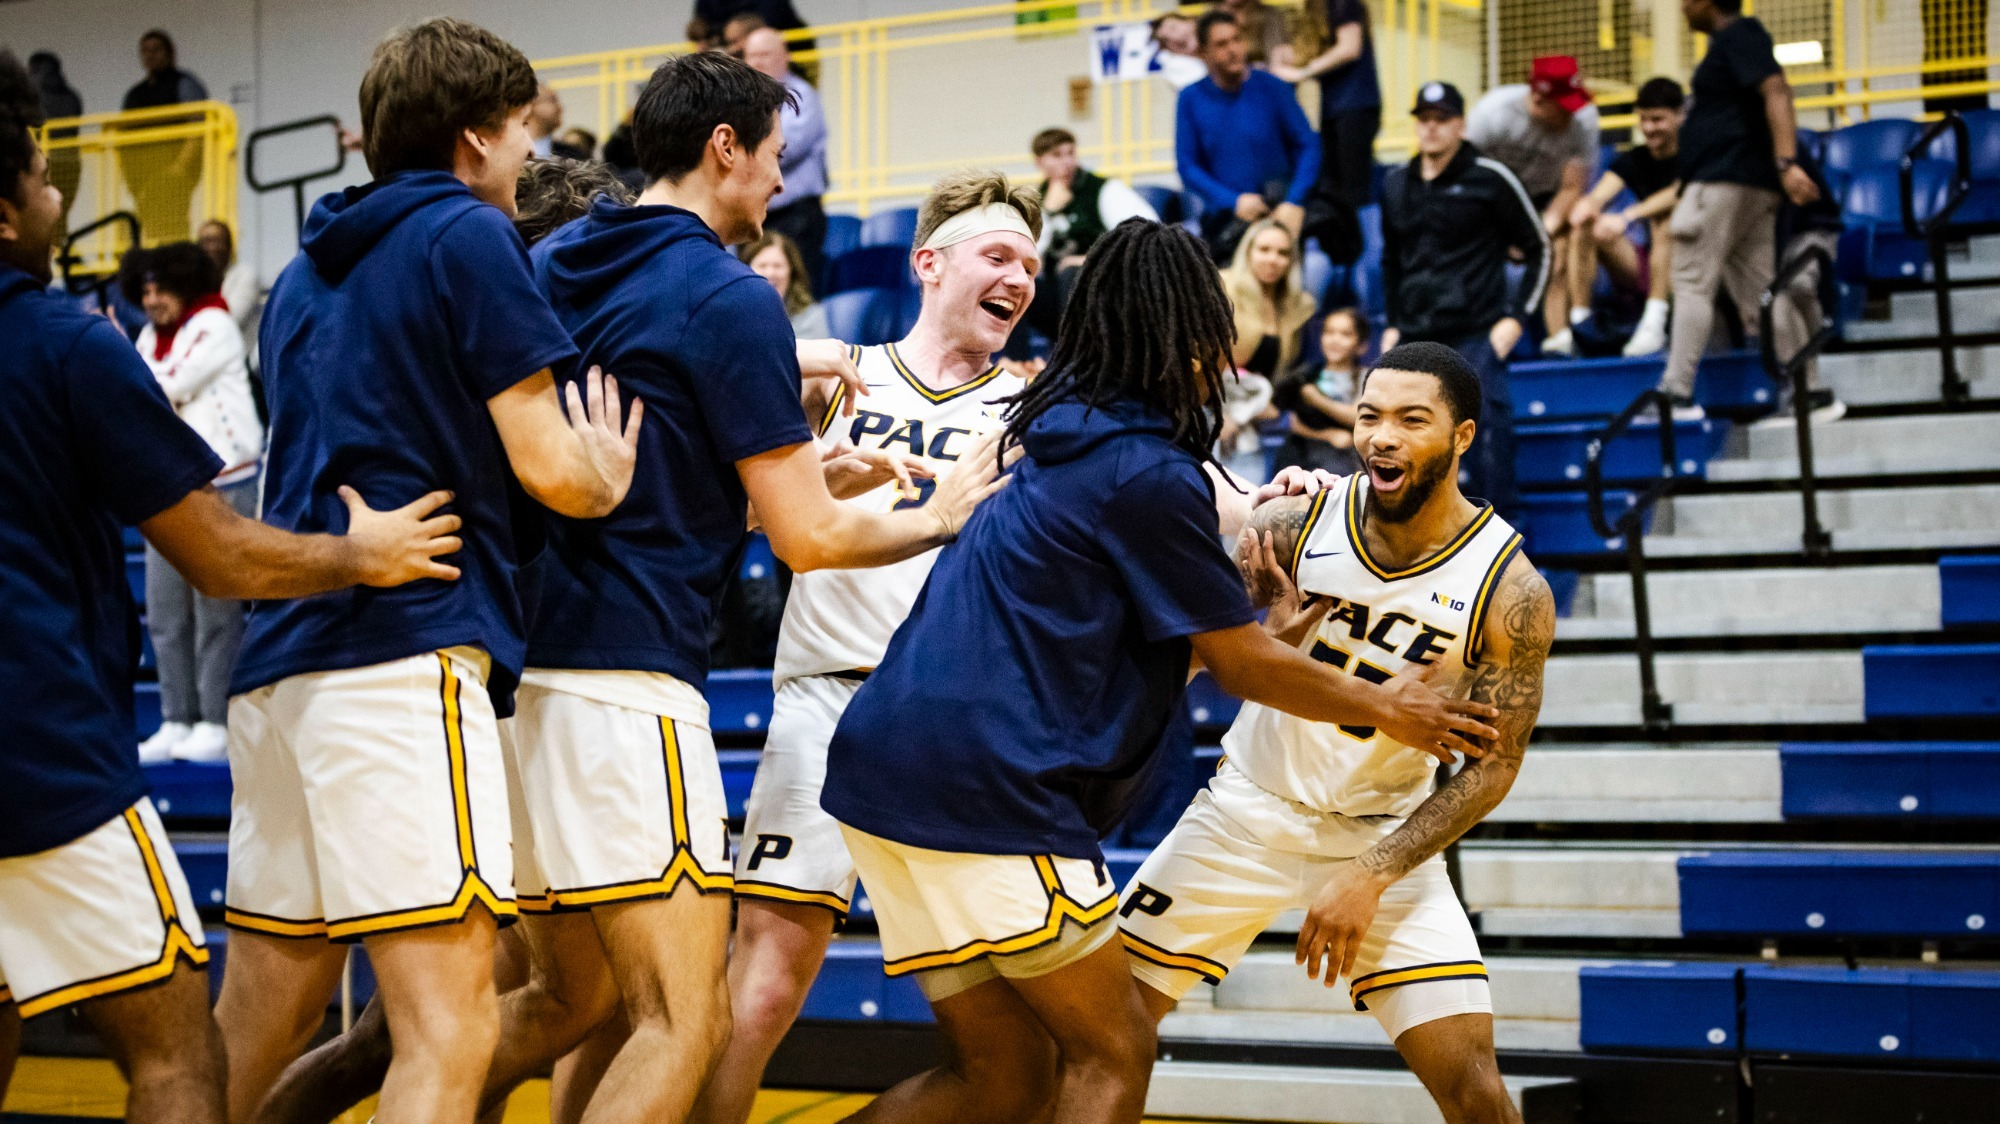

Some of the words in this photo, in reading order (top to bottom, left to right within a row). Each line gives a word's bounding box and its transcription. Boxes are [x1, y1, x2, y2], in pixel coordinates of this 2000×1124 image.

[848, 408, 983, 462] PAC
[746, 833, 793, 871] P
[1118, 880, 1174, 919] P
